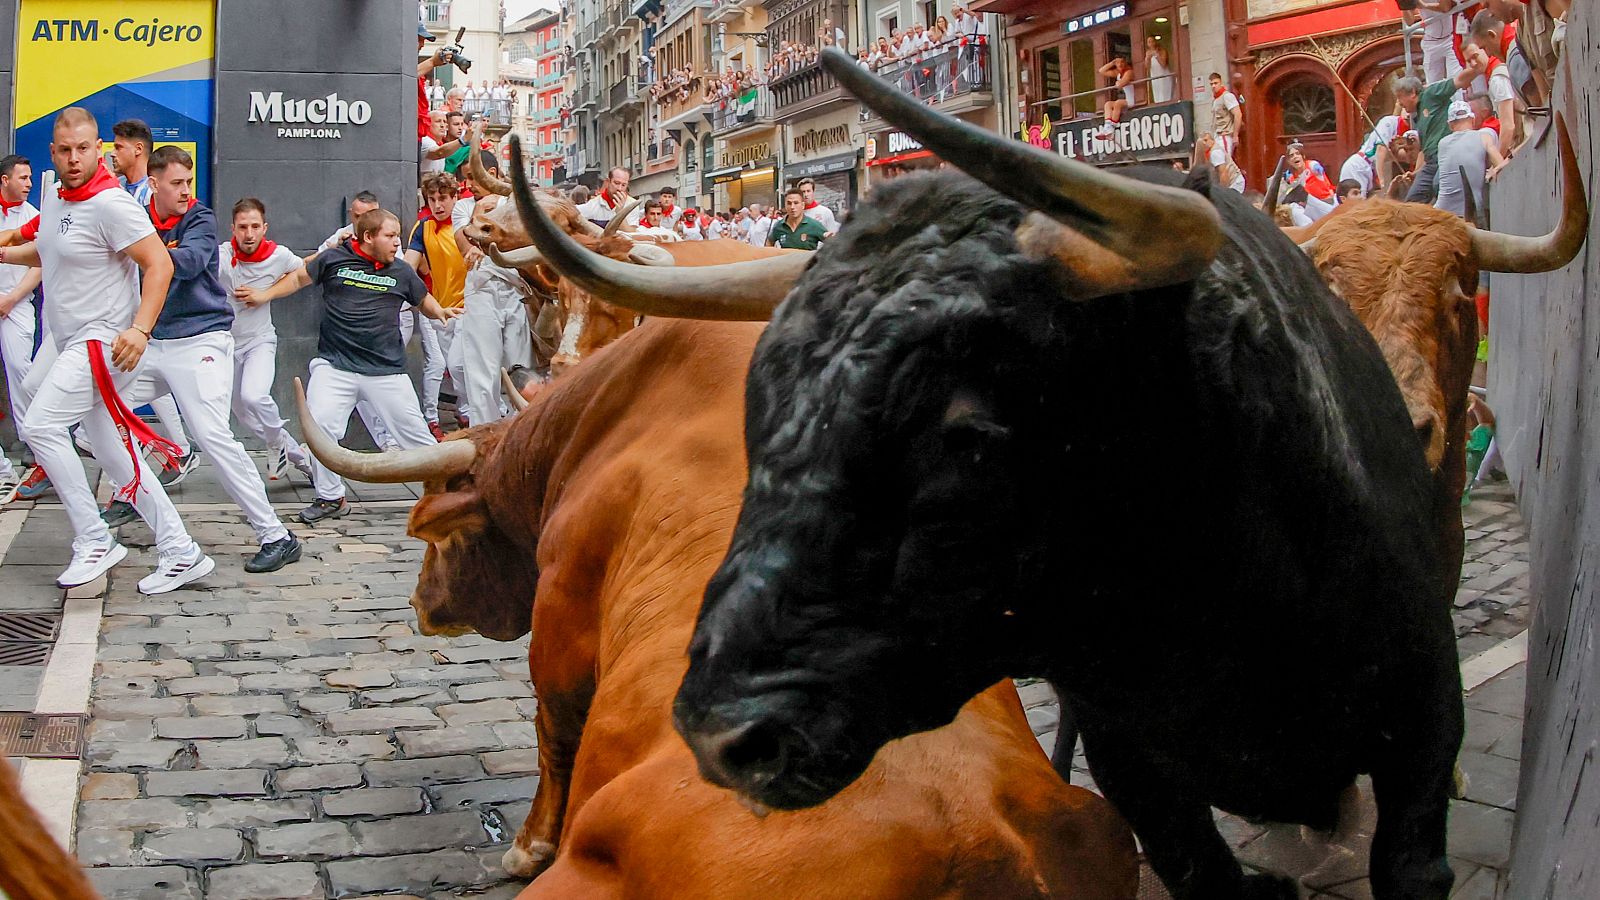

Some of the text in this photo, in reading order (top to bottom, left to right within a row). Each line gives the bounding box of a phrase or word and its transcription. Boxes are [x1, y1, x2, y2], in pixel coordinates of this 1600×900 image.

[32, 18, 202, 47] ATM Cajero
[248, 92, 372, 125] Mucho
[277, 128, 341, 138] PAMPLONA
